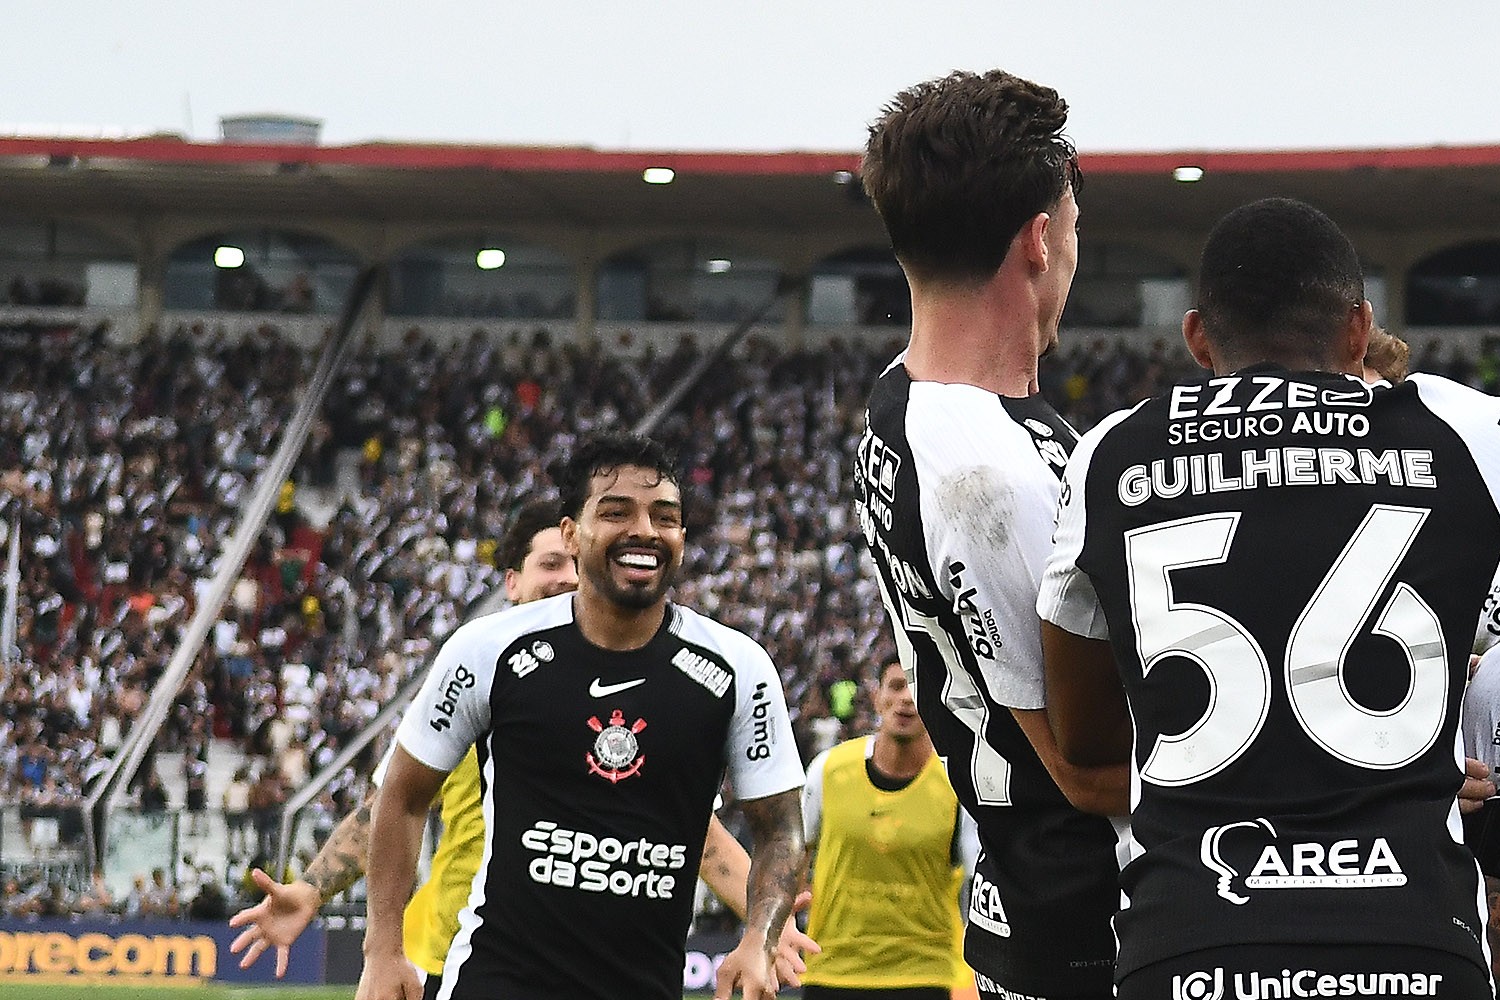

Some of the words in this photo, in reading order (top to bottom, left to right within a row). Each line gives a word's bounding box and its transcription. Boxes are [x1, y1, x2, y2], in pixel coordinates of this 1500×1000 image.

[1169, 376, 1318, 420] EZZE
[1167, 413, 1284, 446] SEGURO
[1290, 411, 1370, 438] AUTO
[1118, 446, 1438, 507] GUILHERME
[983, 608, 1003, 648] banco
[1123, 503, 1451, 788] 56
[434, 663, 476, 718] bmg
[746, 701, 772, 762] bmg
[521, 820, 687, 869] Esportes
[1251, 837, 1403, 876] AREA
[579, 860, 676, 899] Sorte
[971, 871, 1008, 923] REA
